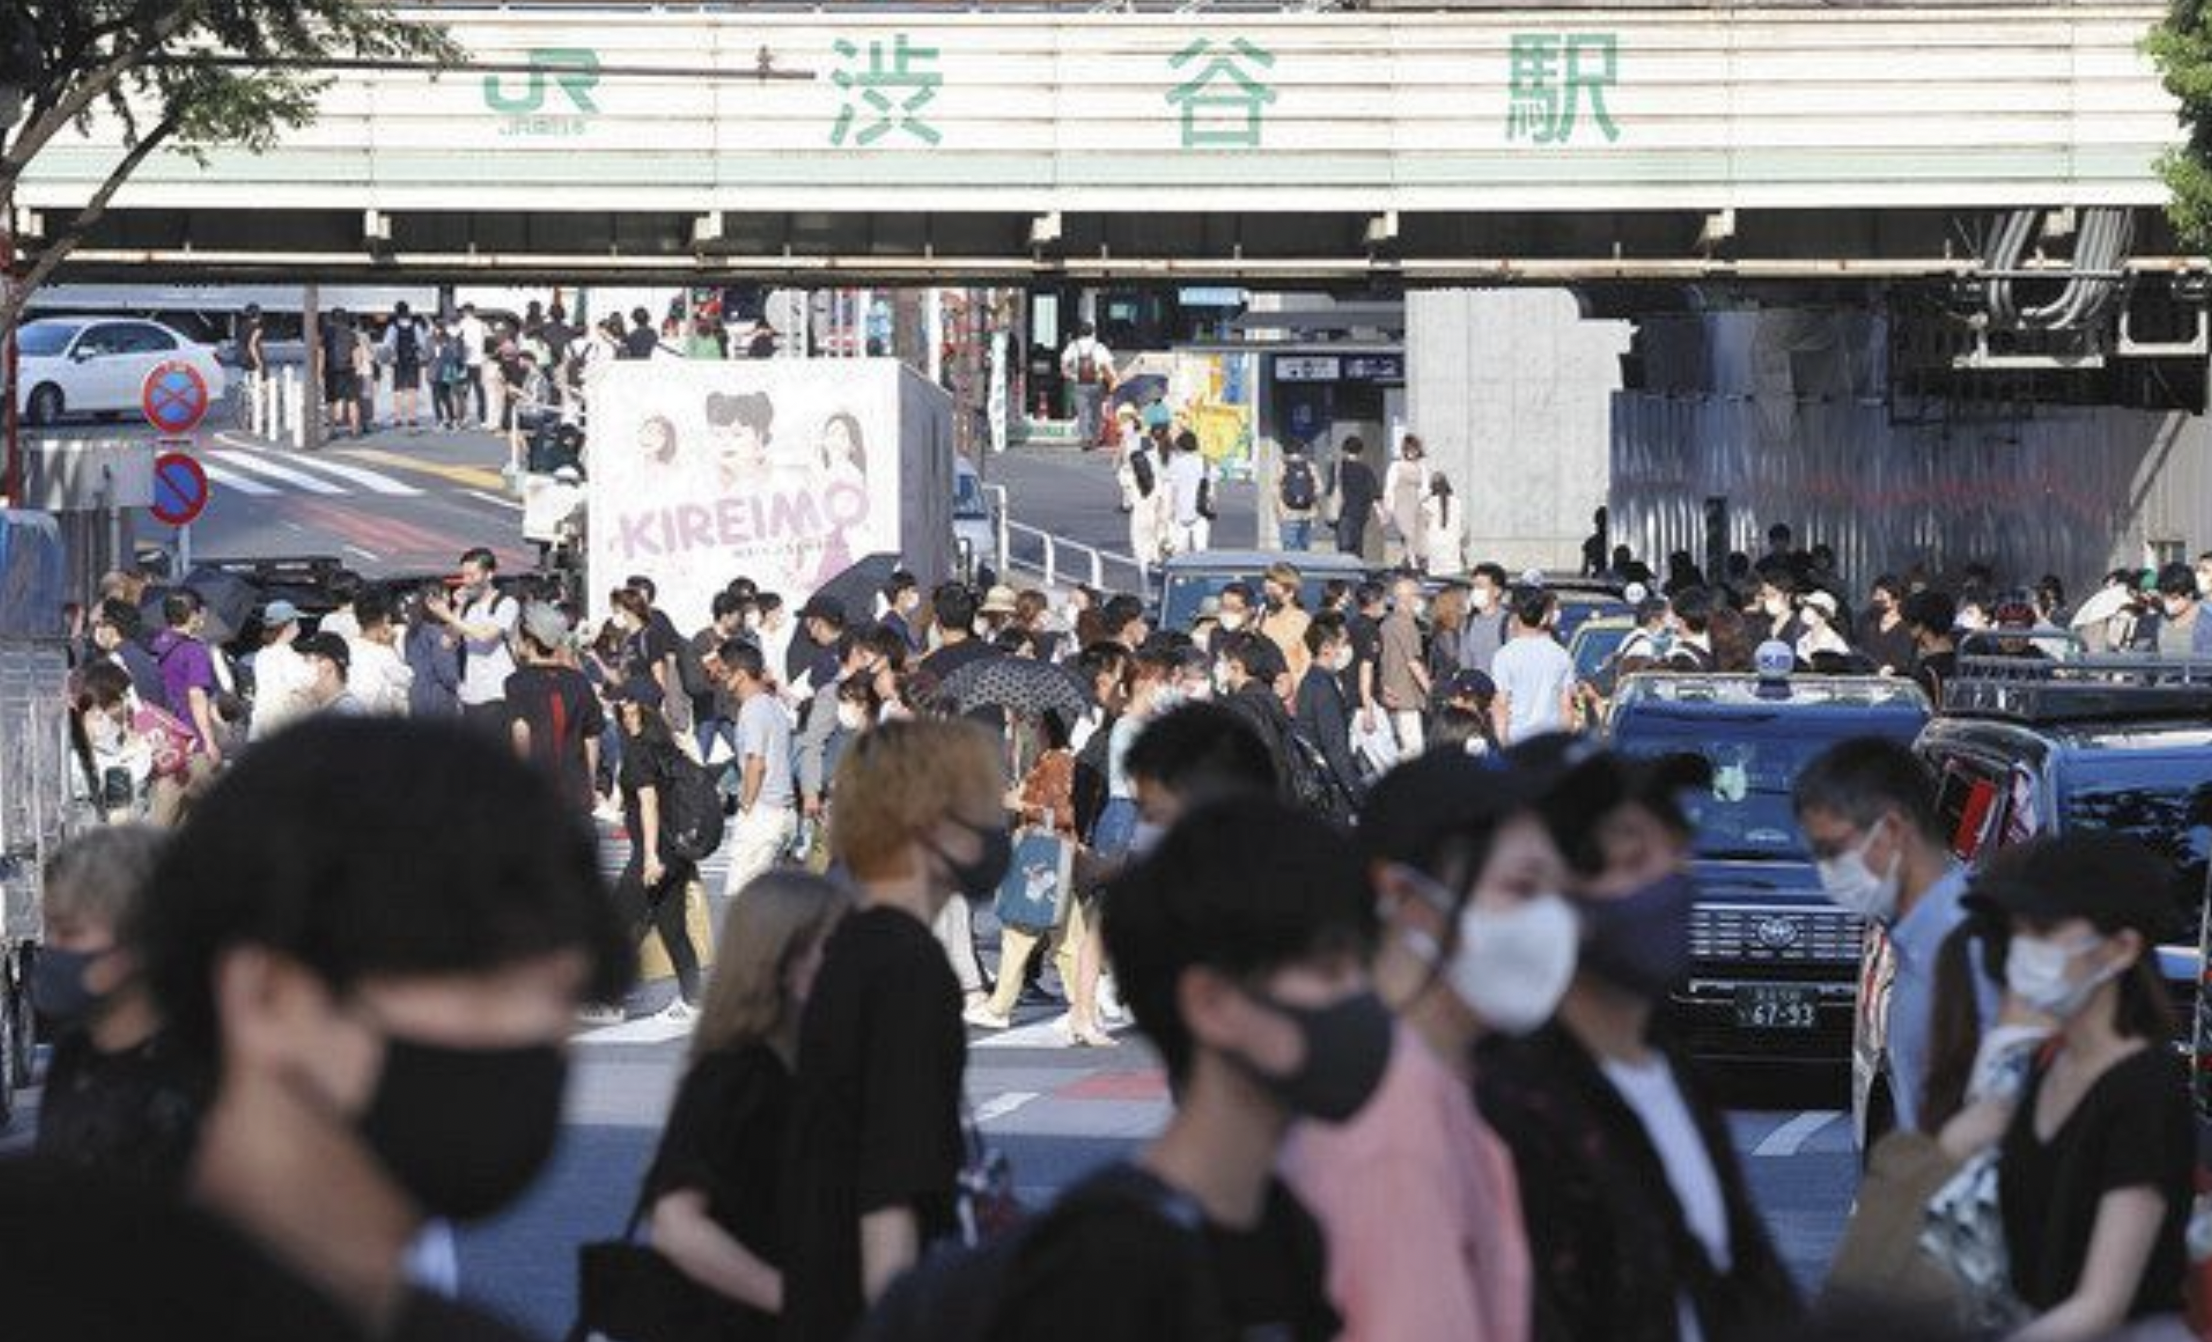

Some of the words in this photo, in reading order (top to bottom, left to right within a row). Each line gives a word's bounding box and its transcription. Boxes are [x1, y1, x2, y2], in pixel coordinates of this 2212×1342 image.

[484, 48, 600, 114] JR
[829, 33, 1620, 147] 渋谷駅
[618, 481, 869, 559] KIREIMO
